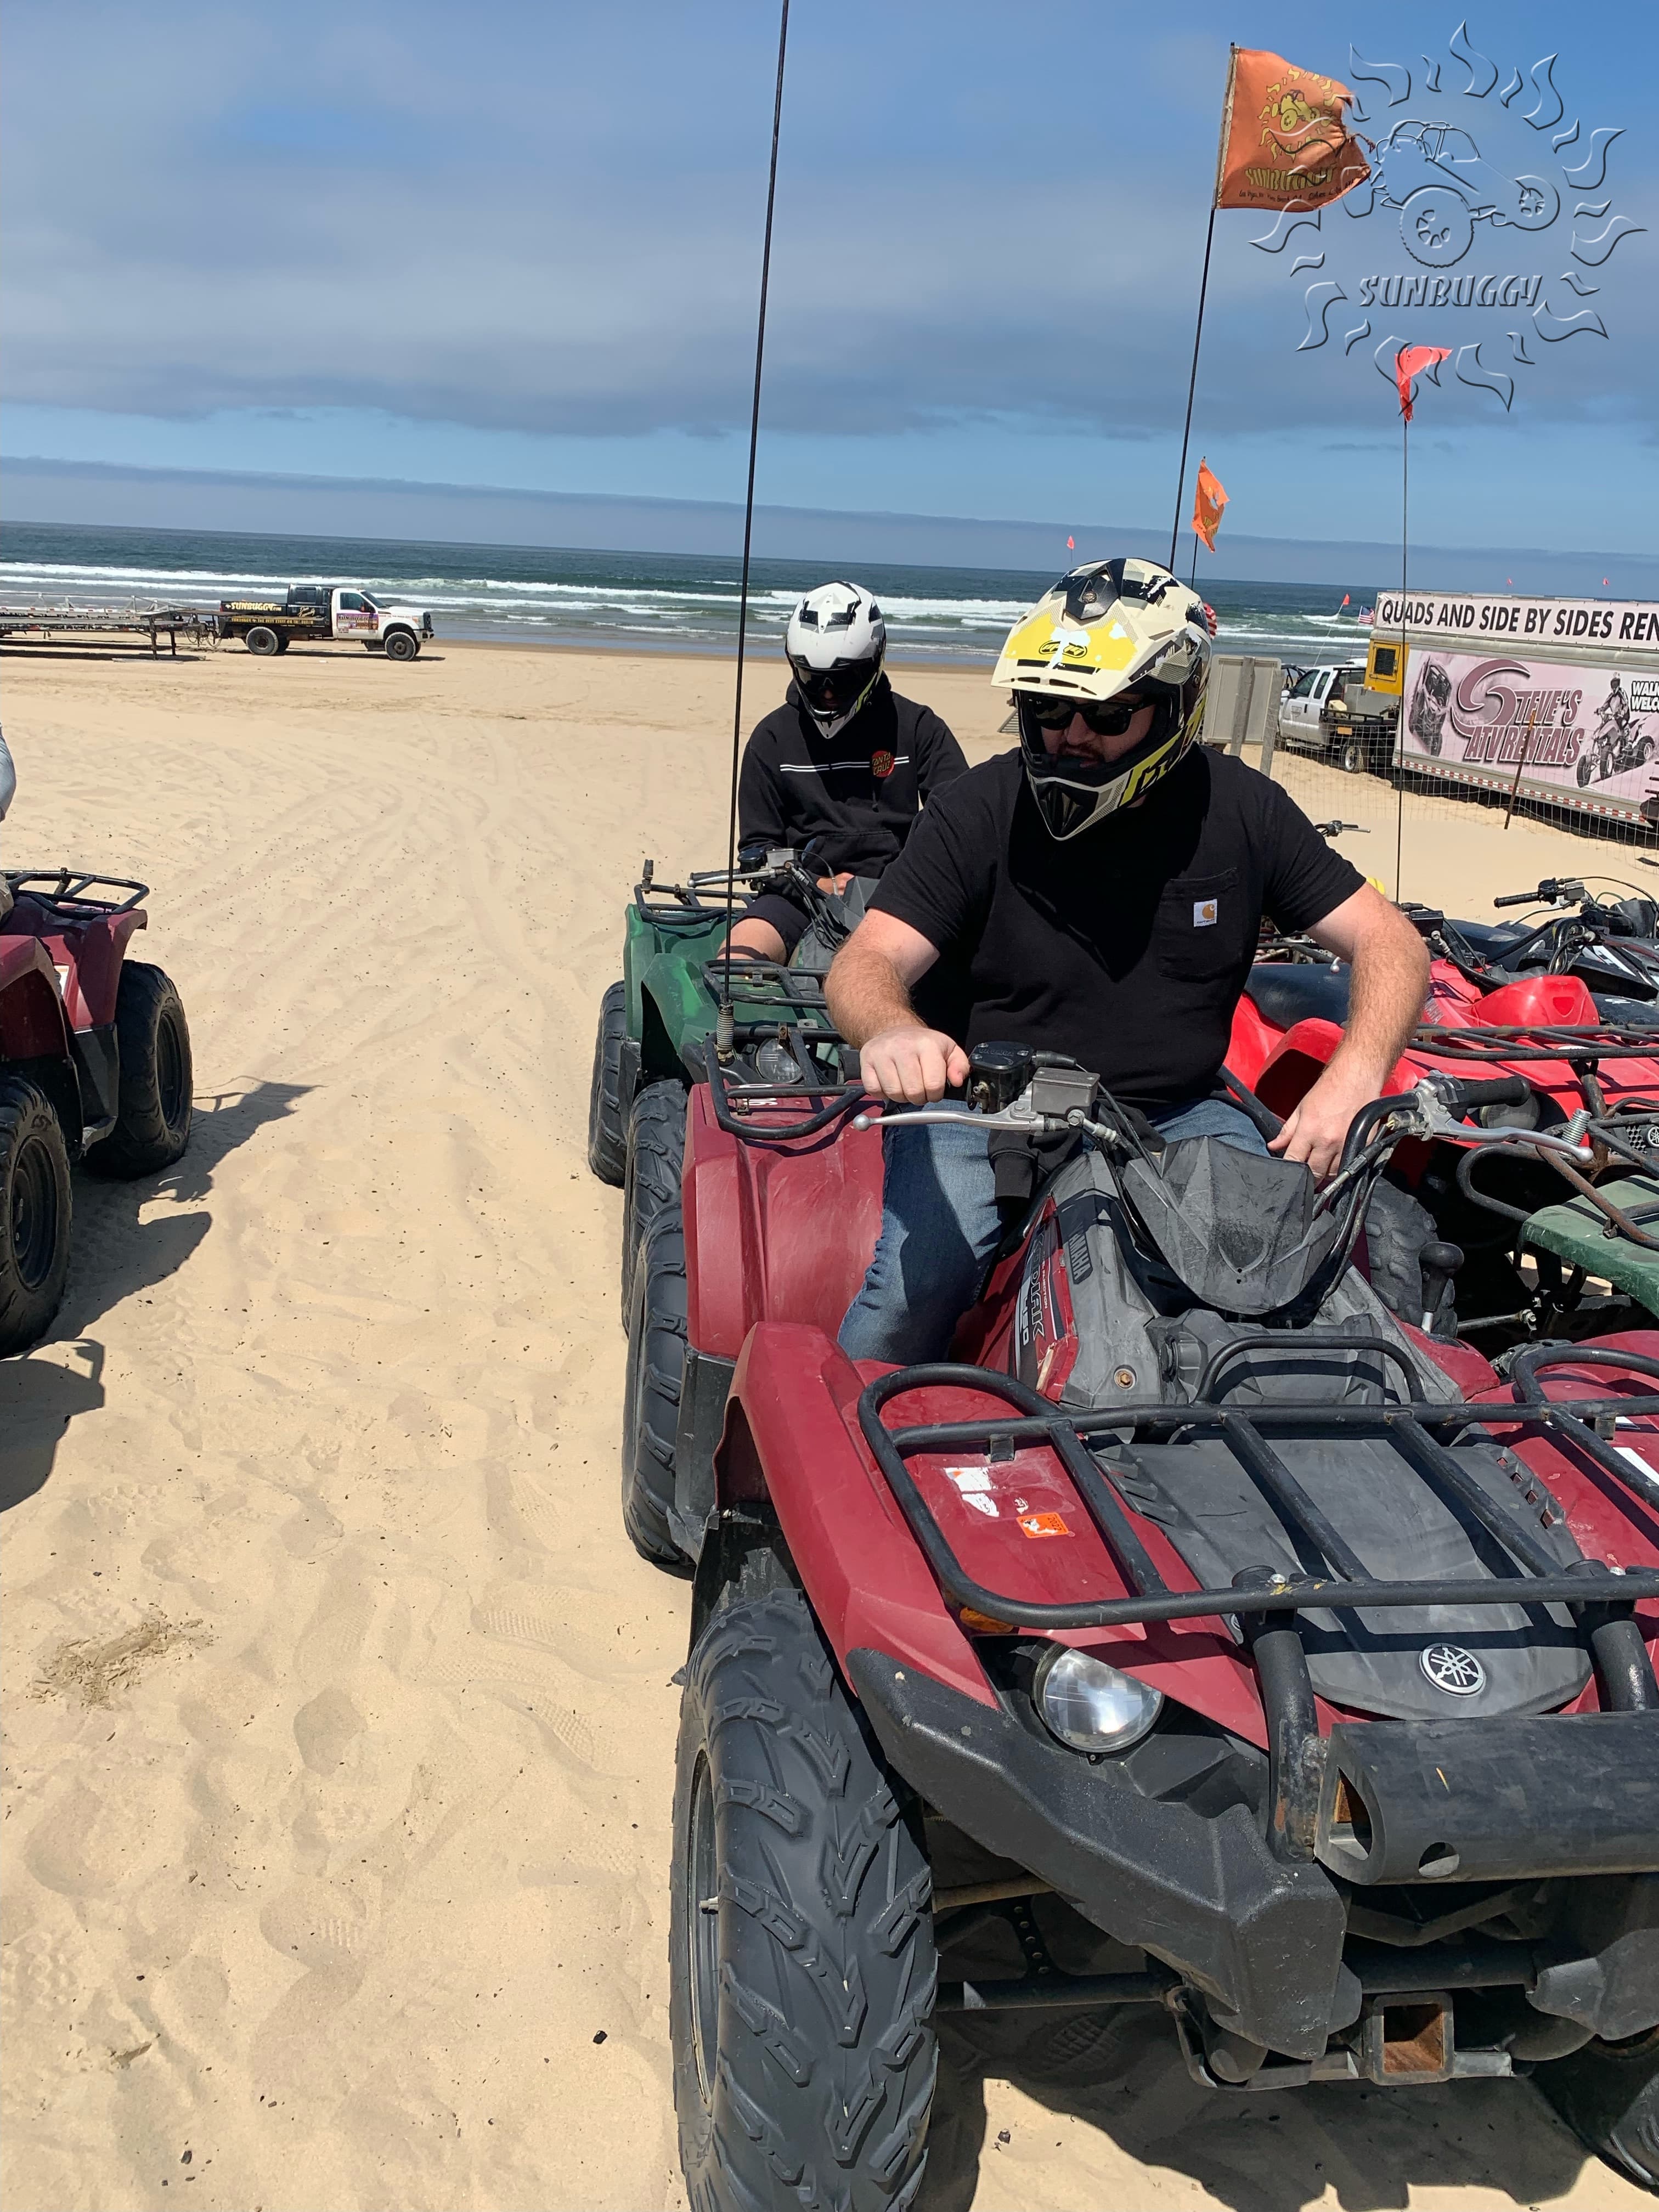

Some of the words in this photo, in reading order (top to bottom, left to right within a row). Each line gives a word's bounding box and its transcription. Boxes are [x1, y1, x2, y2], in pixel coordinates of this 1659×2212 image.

[1382, 600, 1434, 625] QUADS
[1437, 603, 1475, 628] AND
[1479, 605, 1521, 632] SIDE
[1524, 608, 1552, 634] BY
[1553, 609, 1615, 639] SIDES
[1452, 658, 1583, 736] STEVE'S
[1630, 696, 1659, 712] WELC
[1464, 725, 1506, 761] ATV
[1499, 725, 1585, 766] RENTALS
[873, 760, 891, 775] CRUZ
[1069, 1223, 1092, 1280] YAMAHA
[1030, 1224, 1046, 1341] KODIAK
